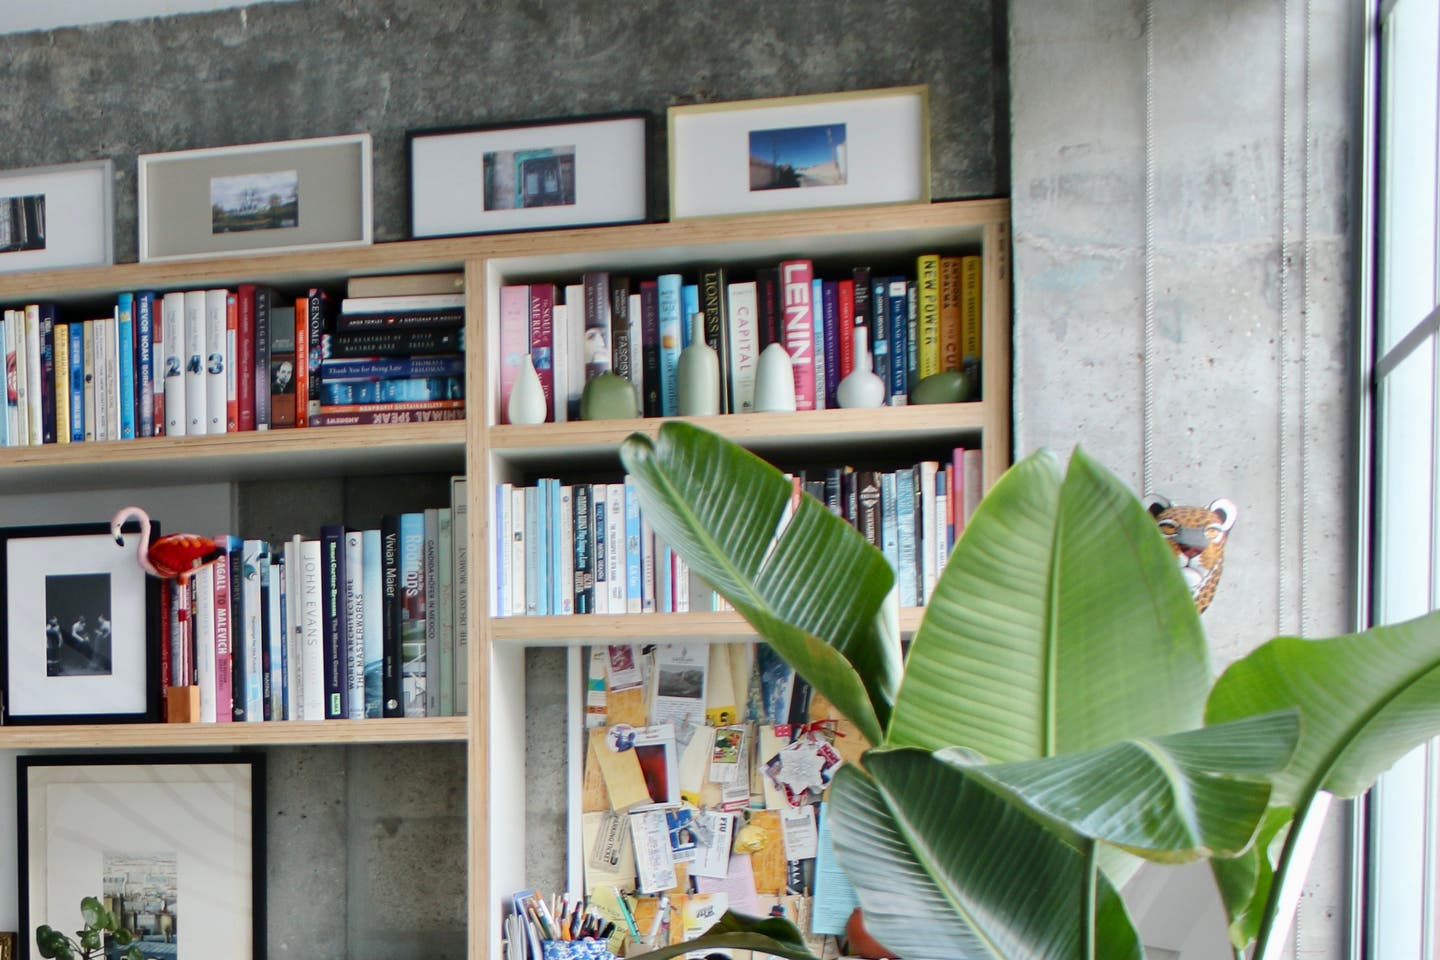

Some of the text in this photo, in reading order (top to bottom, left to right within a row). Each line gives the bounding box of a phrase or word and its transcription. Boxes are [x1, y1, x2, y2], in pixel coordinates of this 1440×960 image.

[705, 272, 720, 333] LIONESS
[924, 260, 938, 345] NEW POWER
[951, 262, 959, 308] ANTHONY
[141, 296, 149, 361] TREVOR NOAH
[311, 297, 320, 344] GENOME
[531, 296, 540, 345] AMERICA
[542, 307, 550, 335] SOUL
[784, 263, 811, 365] LENIN
[618, 335, 628, 381] FASCISM
[737, 306, 751, 372] CAPITAL
[166, 354, 181, 378] 2
[208, 353, 224, 375] 3
[371, 366, 388, 374] Being
[373, 412, 410, 424] SPEAK
[385, 533, 396, 598] Vivian Maier
[427, 540, 435, 573] CANDIDA
[303, 555, 318, 646] JOHN EVANS
[330, 541, 339, 687] Henri Cartier-Bresson The Modern Century
[347, 579, 355, 657] ARCHITECTURE
[458, 547, 467, 646] THE DECISIVE MOMENT
[217, 594, 228, 654] TO MALEVICH
[428, 610, 436, 639] MEXICO
[719, 816, 728, 833] FIU
